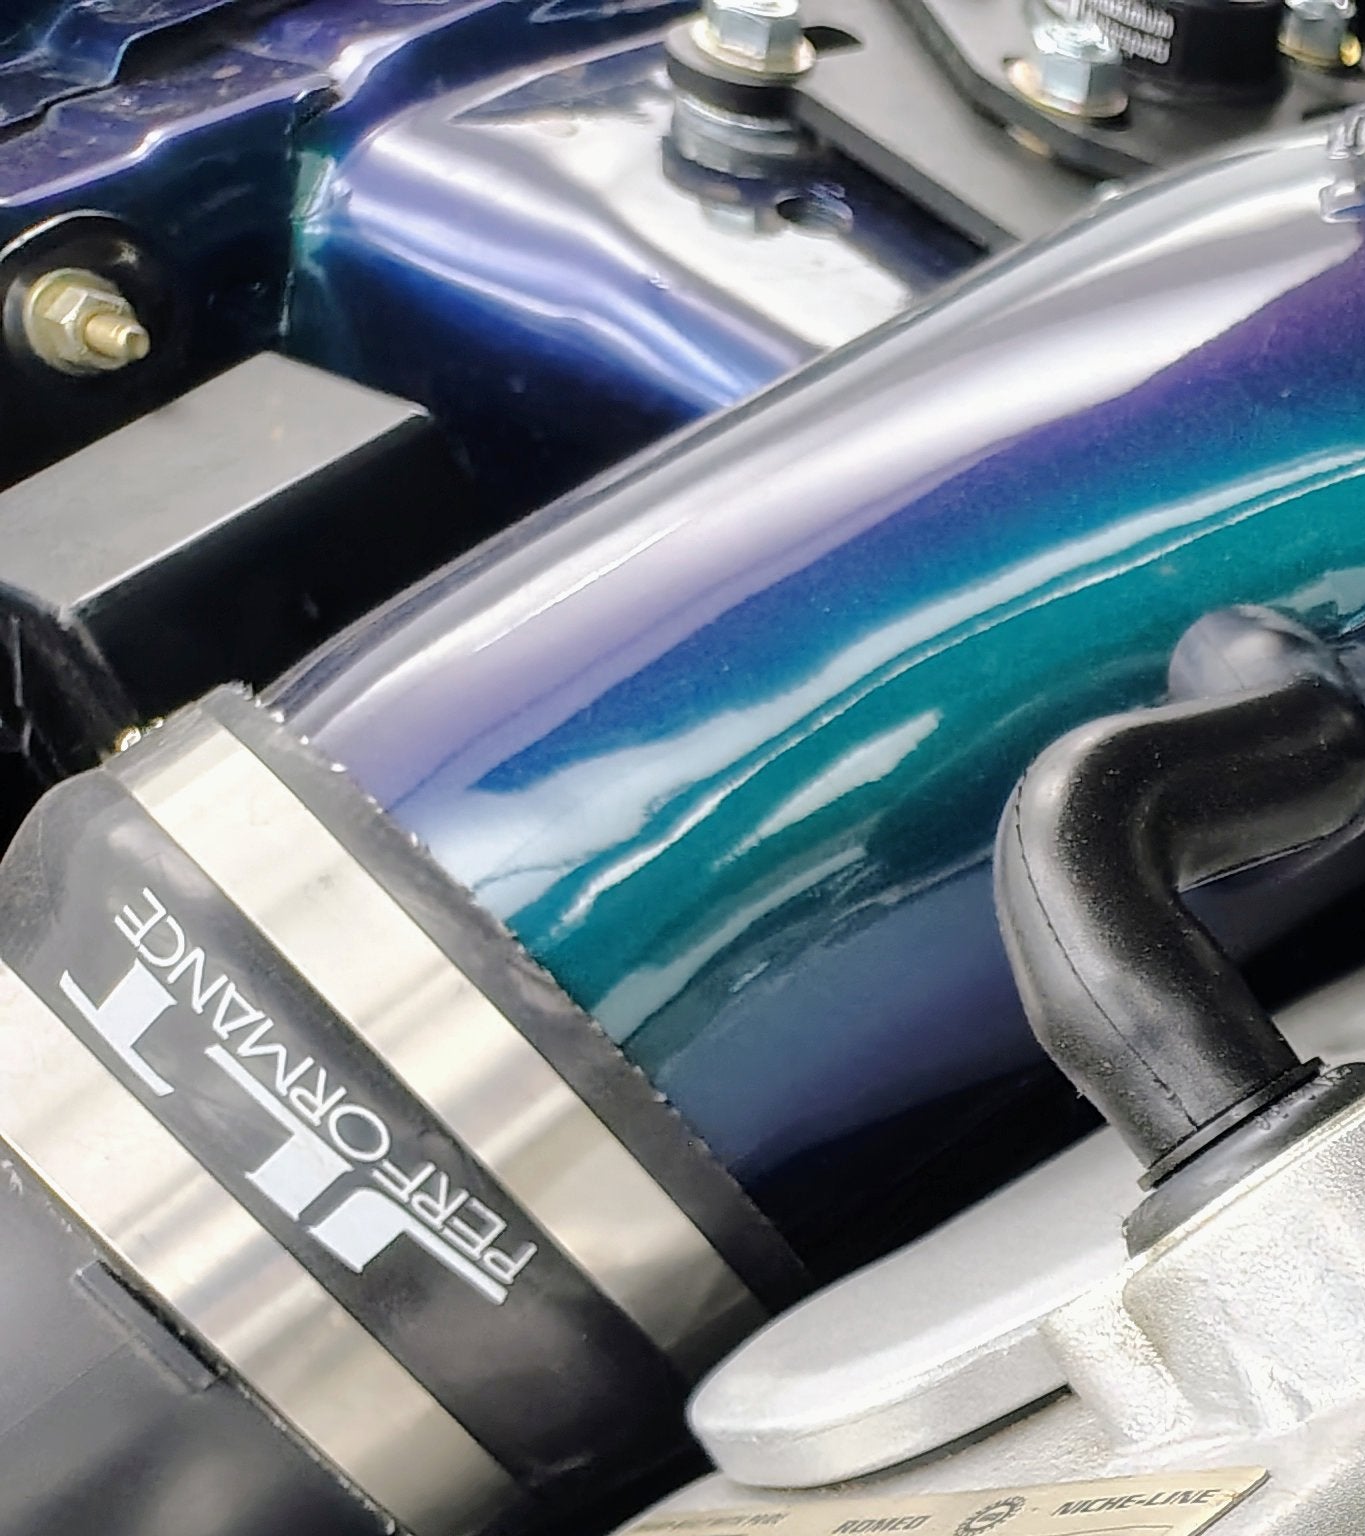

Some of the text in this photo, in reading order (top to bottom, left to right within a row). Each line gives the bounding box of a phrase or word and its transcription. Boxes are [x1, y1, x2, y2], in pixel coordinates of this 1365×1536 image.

[59, 959, 509, 1305] JLT
[114, 888, 538, 1284] PERFORMANCE
[833, 1514, 930, 1535] ROMEO
[1054, 1489, 1219, 1516] NICHE-LINE
